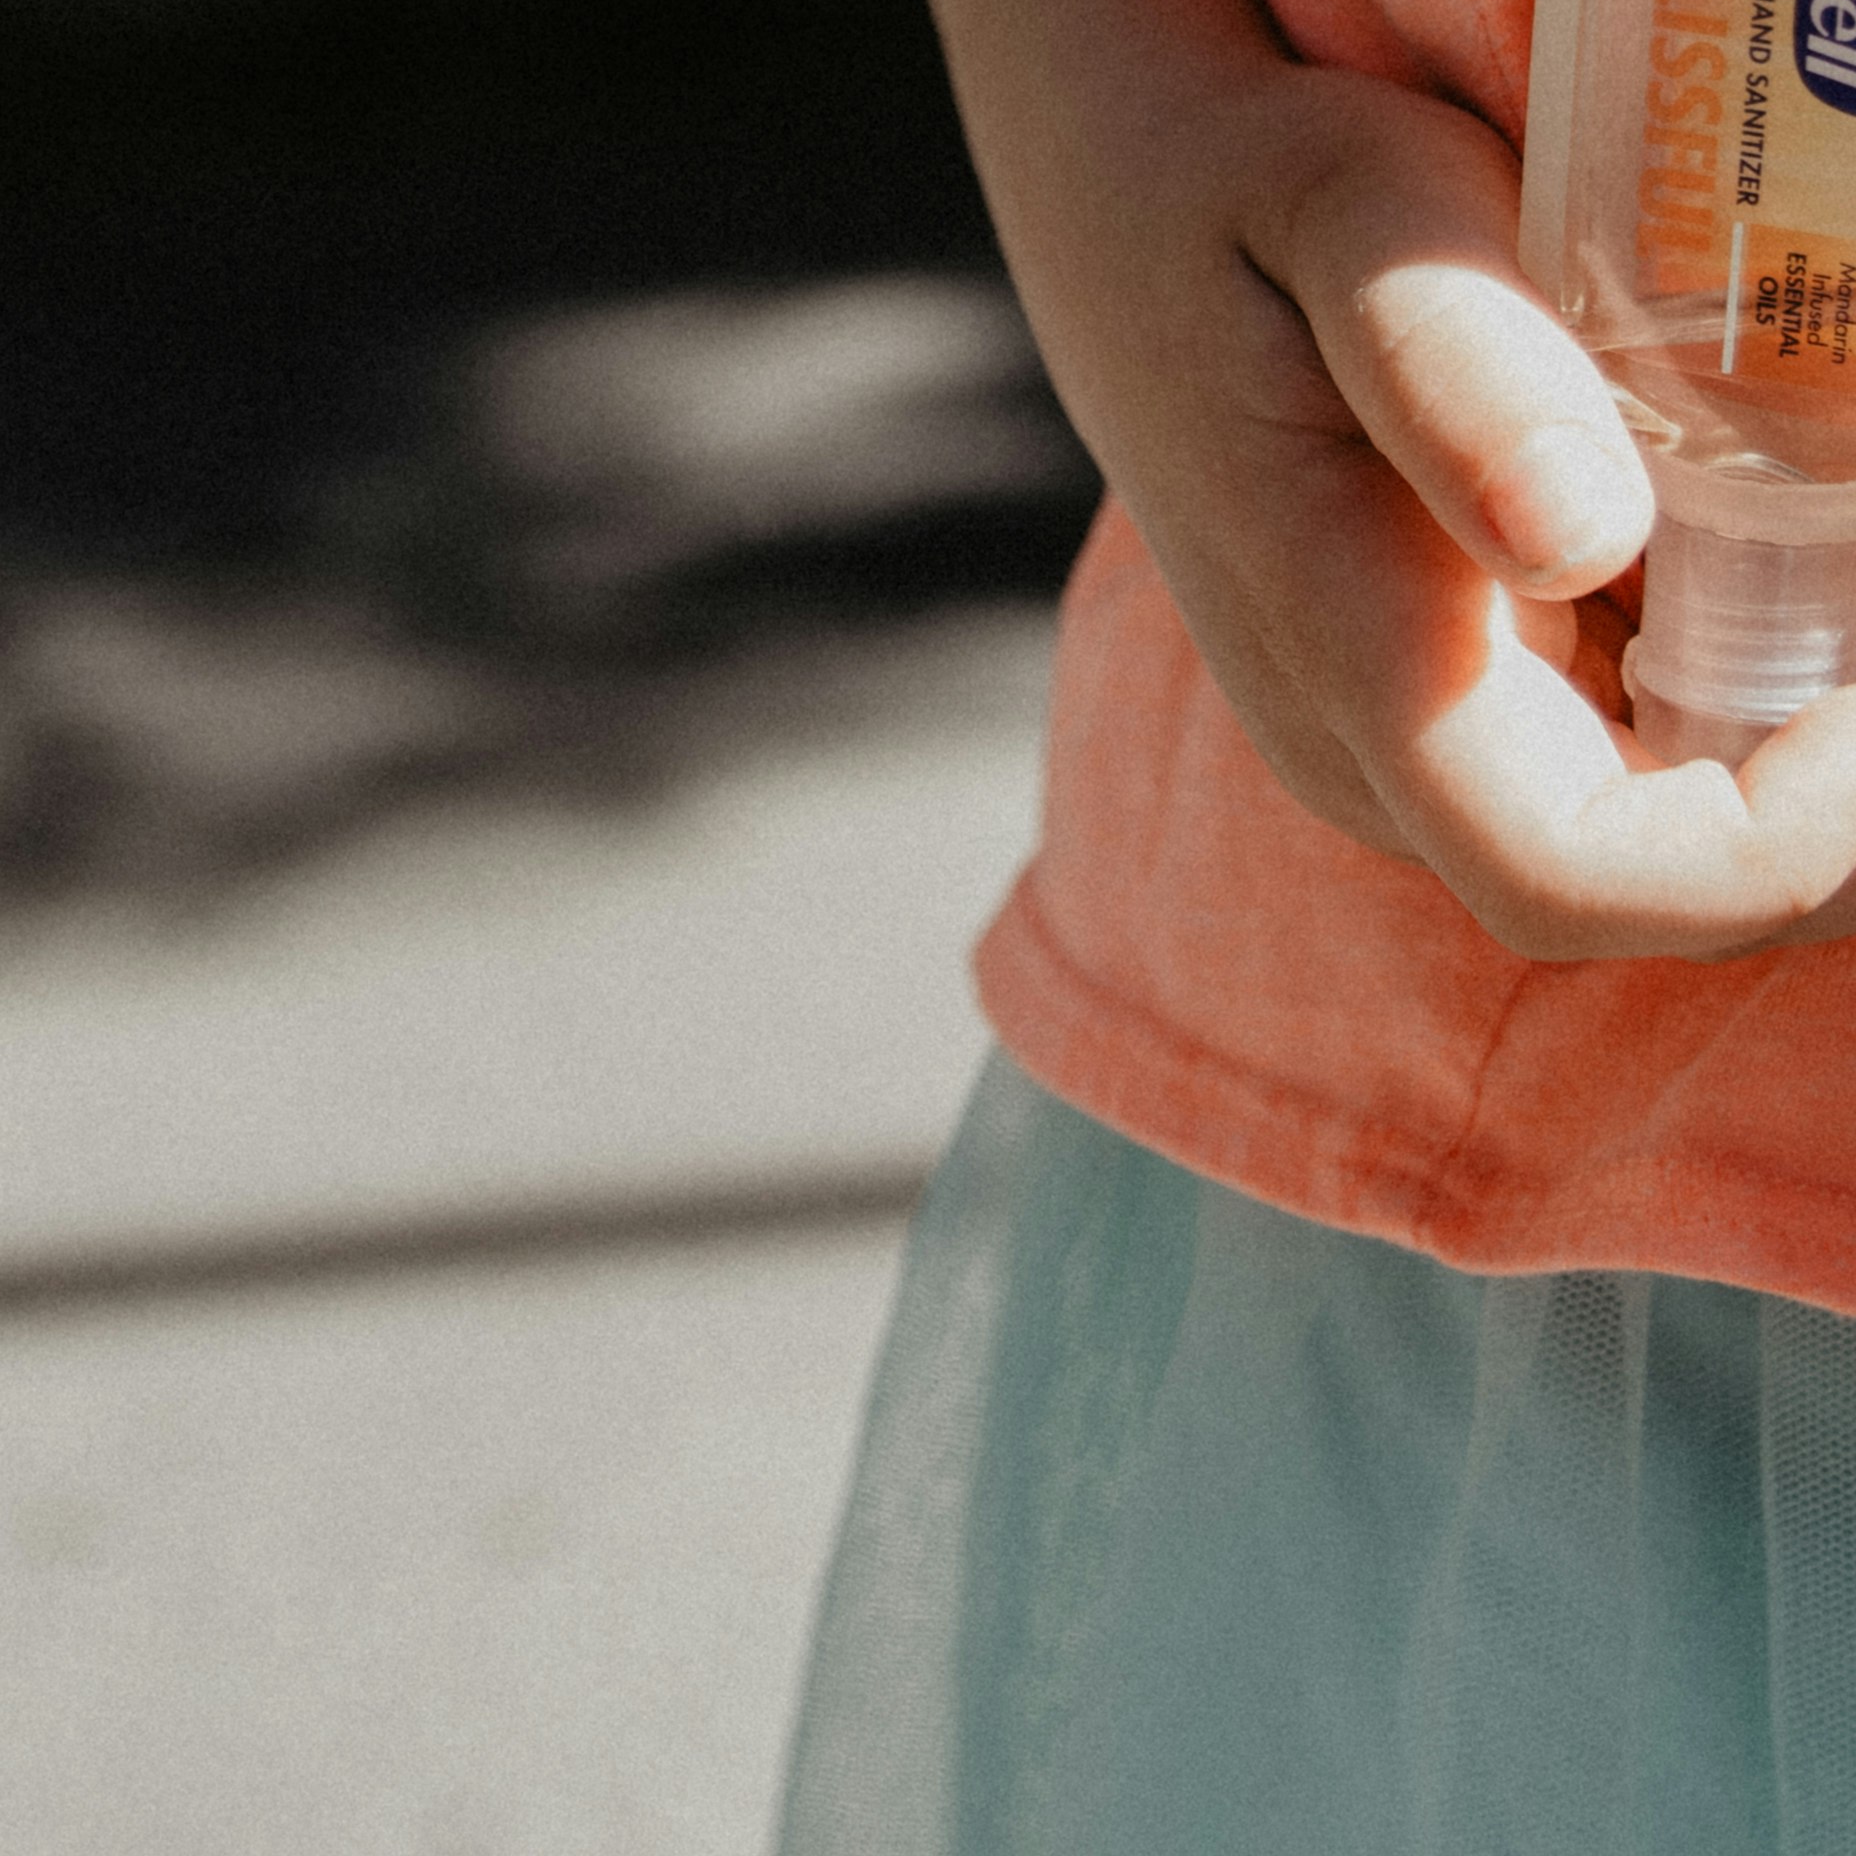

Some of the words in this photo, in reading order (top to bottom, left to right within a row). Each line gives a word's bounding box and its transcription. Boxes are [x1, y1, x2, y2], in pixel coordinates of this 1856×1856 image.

[1736, 73, 1769, 206] SANITIZER
[1756, 276, 1779, 326] OILS
[1779, 252, 1807, 358] ESSENTIAL
[1807, 274, 1833, 347] Infused
